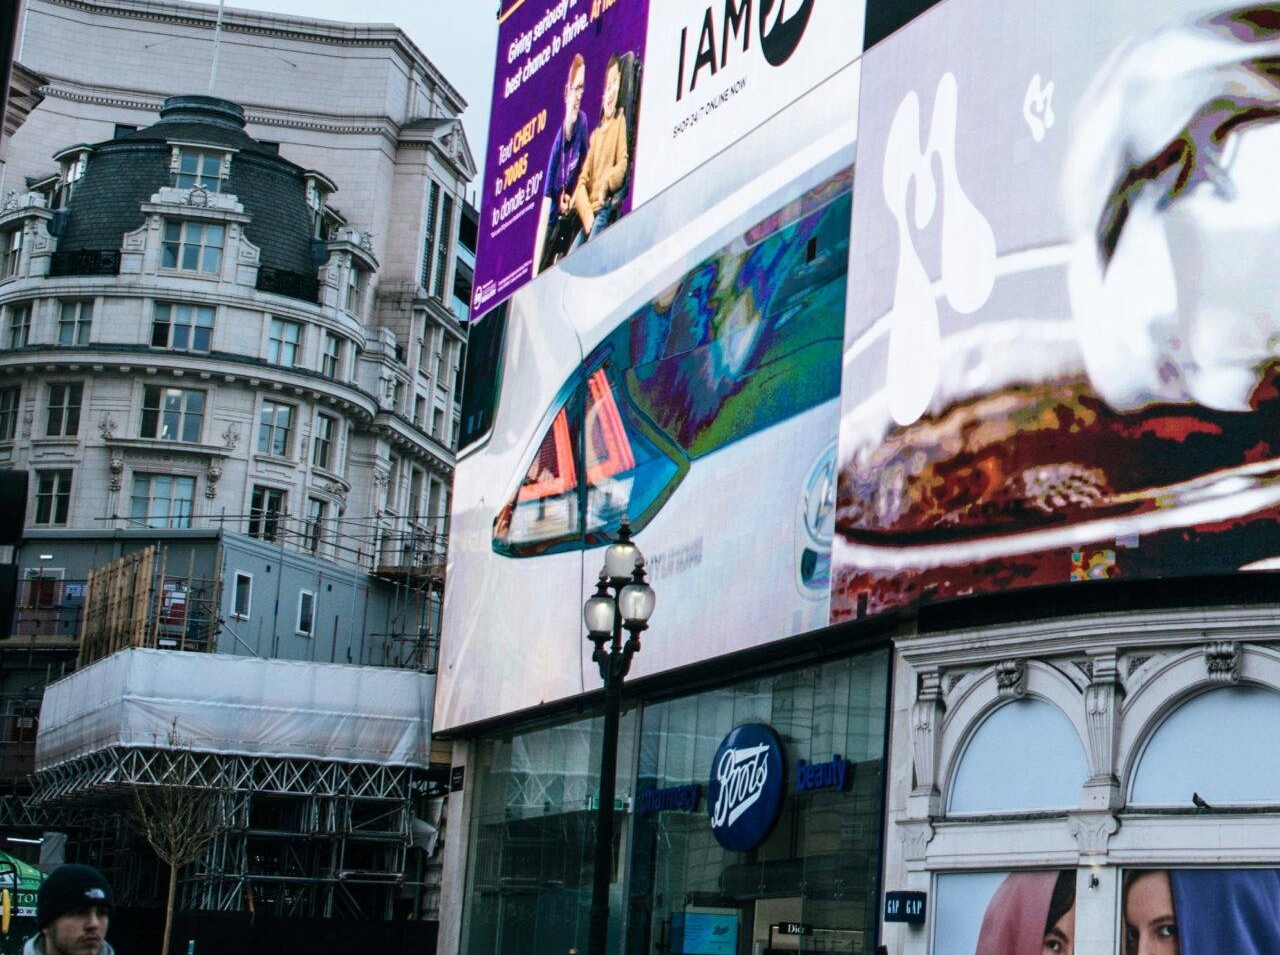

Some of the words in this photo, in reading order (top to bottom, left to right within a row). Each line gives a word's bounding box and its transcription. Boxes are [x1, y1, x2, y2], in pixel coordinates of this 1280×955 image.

[504, 67, 522, 99] best
[523, 45, 551, 82] chance
[551, 35, 561, 57] to
[562, 13, 589, 47] thrive.
[507, 30, 533, 64] Giving
[676, 26, 687, 102] I
[673, 117, 689, 138] SHOP
[705, 88, 729, 115] ONLINE
[731, 75, 748, 96] NOW
[499, 138, 513, 165] Text
[495, 177, 503, 197] to
[492, 208, 500, 227] to
[500, 187, 525, 220] donate
[711, 743, 770, 829] Boots
[797, 754, 850, 792] beauty
[887, 899, 900, 914] GAP
[906, 899, 922, 915] GAP
